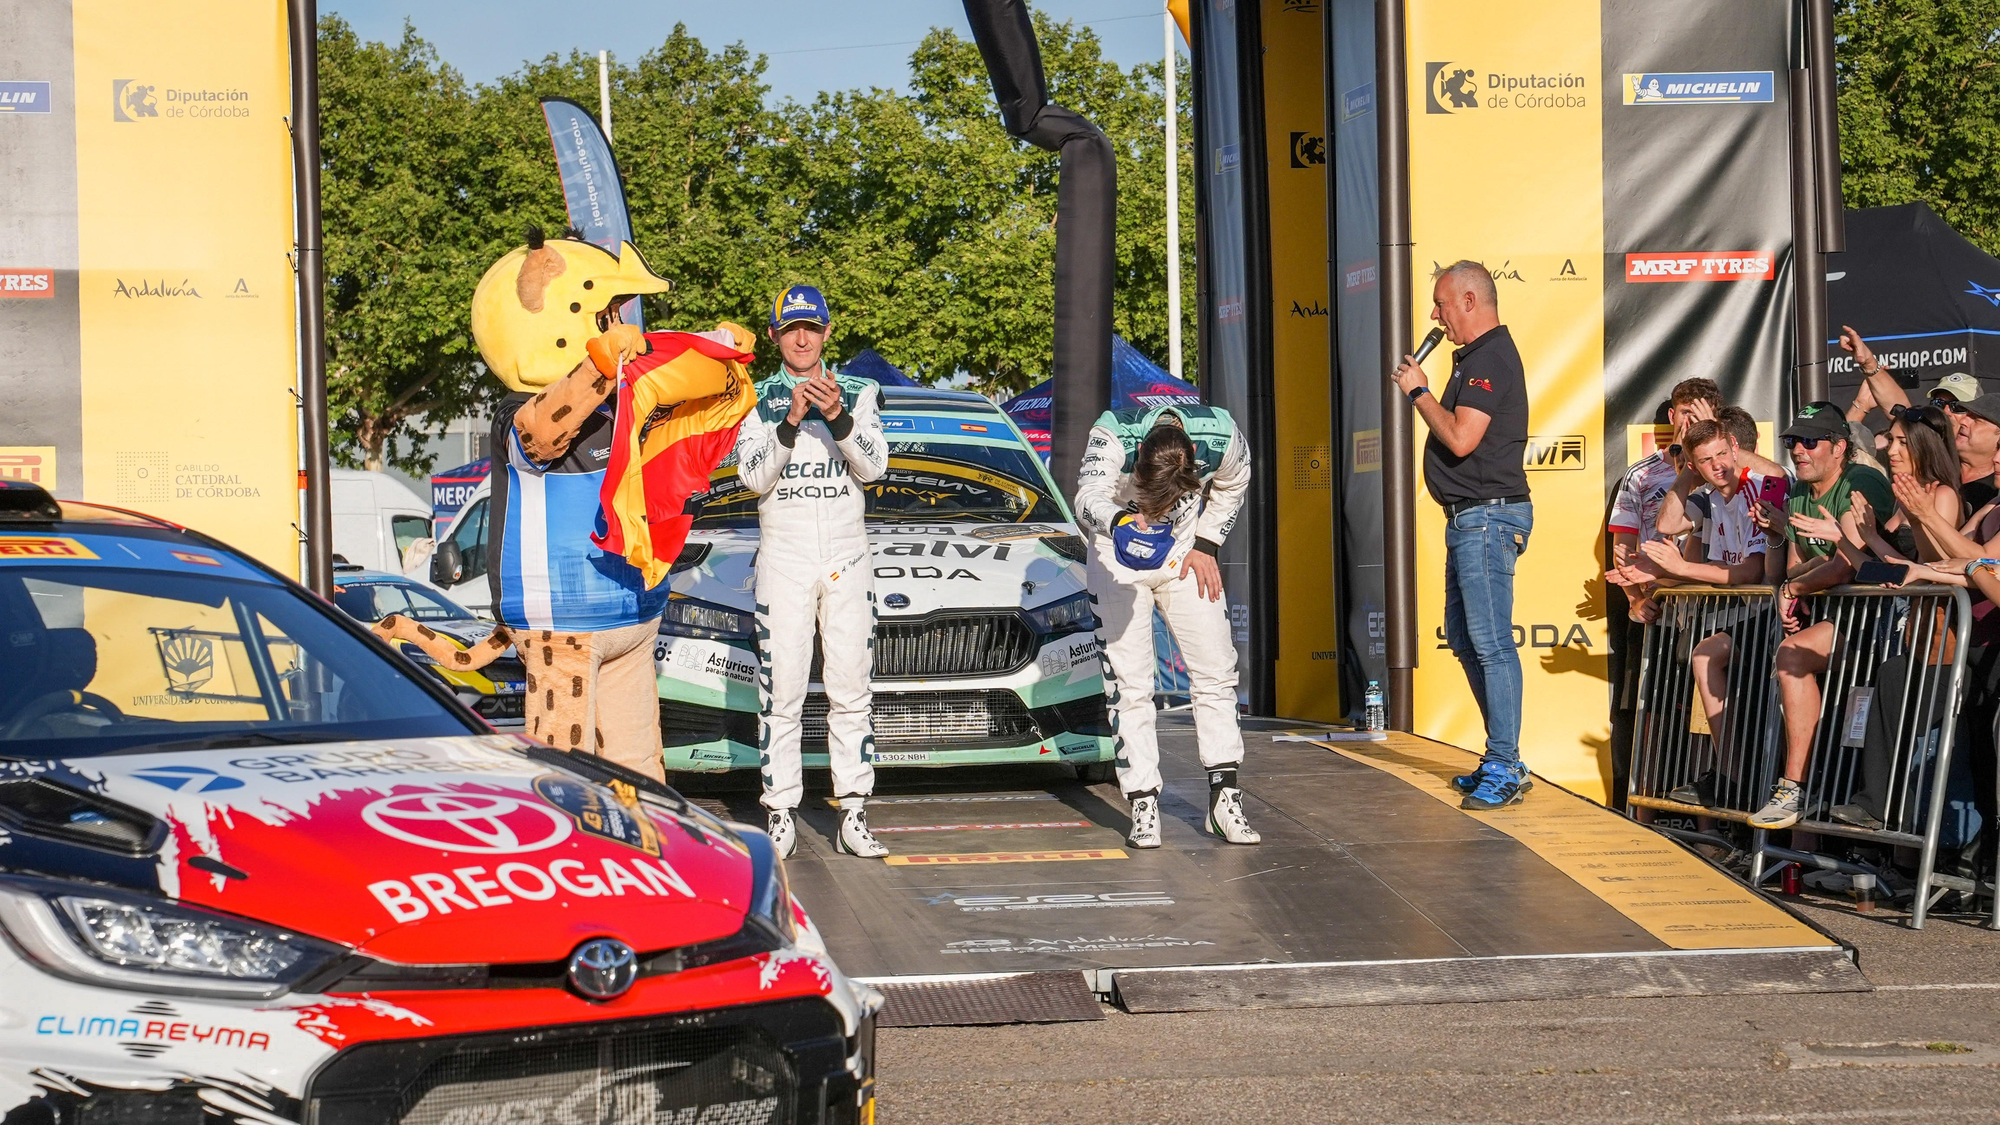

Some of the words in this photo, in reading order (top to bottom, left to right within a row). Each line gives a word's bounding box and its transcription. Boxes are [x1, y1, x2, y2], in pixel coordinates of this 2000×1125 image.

[1488, 73, 1585, 92] Diputación
[1665, 81, 1761, 96] MICHELIN
[166, 88, 249, 103] Diputación
[1487, 94, 1511, 108] de
[1515, 91, 1586, 108] Córdoba
[166, 105, 184, 118] de
[189, 102, 250, 118] Córdoba
[1630, 259, 1697, 276] MRF
[1702, 257, 1770, 275] TYRES
[113, 277, 203, 299] Andalucía
[1828, 347, 1967, 374] RC-NSHOP.COM
[175, 464, 220, 472] CABILDO
[175, 475, 242, 486] CATEDRAL
[176, 487, 193, 498] DE
[197, 485, 261, 498] CÓRDOBA
[873, 566, 982, 582] ODA
[706, 652, 756, 676] Asturias
[882, 753, 906, 761] 5302
[906, 850, 1104, 865] PIRELLI
[367, 858, 697, 923] BREOGAN
